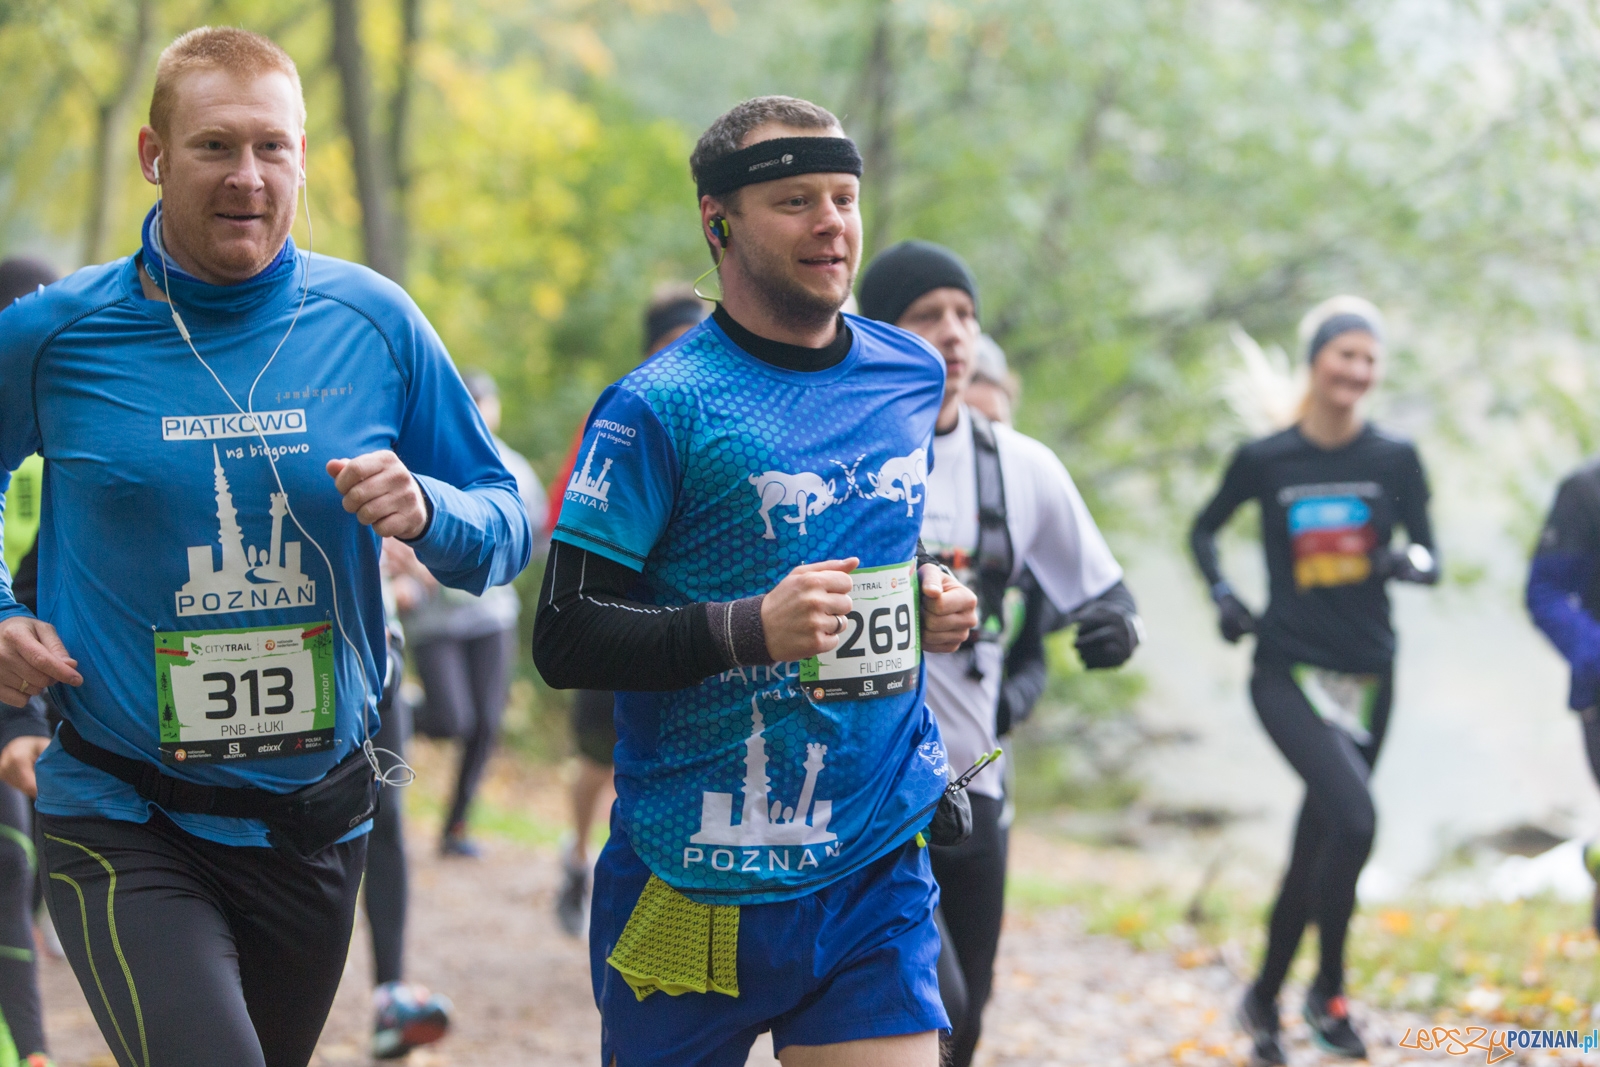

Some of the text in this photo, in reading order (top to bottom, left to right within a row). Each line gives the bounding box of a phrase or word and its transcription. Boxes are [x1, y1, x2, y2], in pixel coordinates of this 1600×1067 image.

[165, 411, 303, 437] PIĄTKOWO
[226, 446, 244, 460] na
[178, 583, 314, 614] POZNAŃ
[836, 603, 911, 660] 269
[860, 658, 903, 675] FILIP PNB
[202, 666, 295, 720] 313
[321, 673, 330, 715] Poznań
[220, 723, 247, 737] PNB
[257, 720, 284, 734] ŁUKI
[682, 840, 844, 872] POZNAŃ
